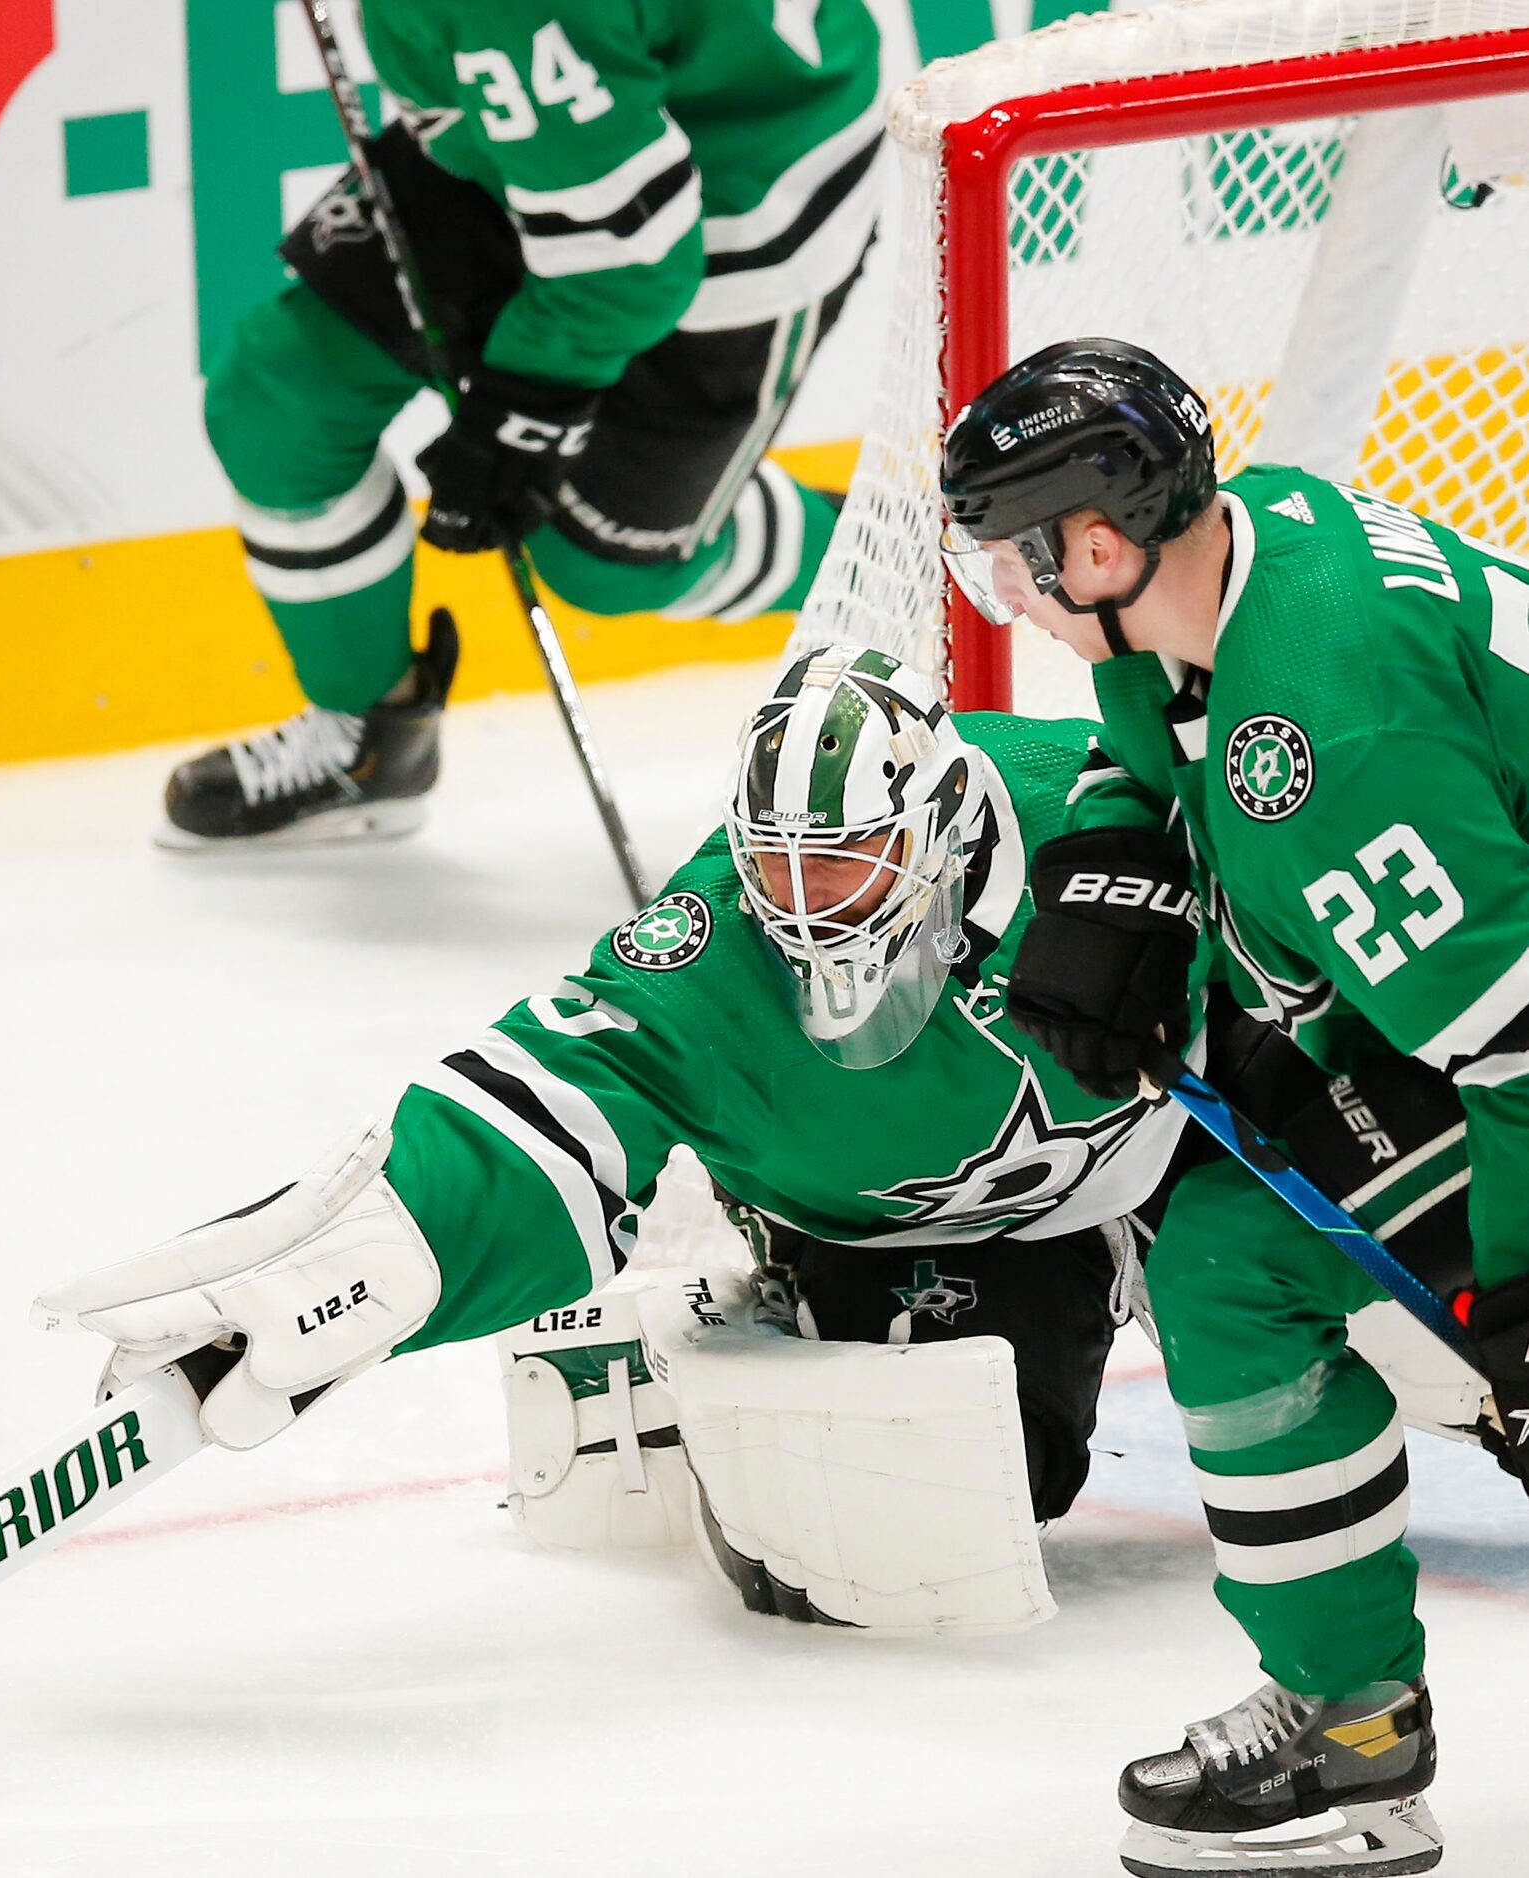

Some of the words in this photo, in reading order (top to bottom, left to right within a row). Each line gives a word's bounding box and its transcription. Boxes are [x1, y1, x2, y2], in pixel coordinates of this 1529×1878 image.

[454, 21, 615, 142] 34
[1017, 405, 1063, 430] ENERGY
[1021, 411, 1080, 441] TRANSFER
[1231, 722, 1292, 788] DALLAS
[1253, 757, 1307, 814] STARS
[645, 897, 704, 947] ALLAS
[1301, 823, 1465, 987] 23
[619, 924, 671, 964] STARS
[296, 1280, 369, 1337] L12.2
[533, 1306, 602, 1334] L12.2
[682, 1277, 728, 1326] TRUE
